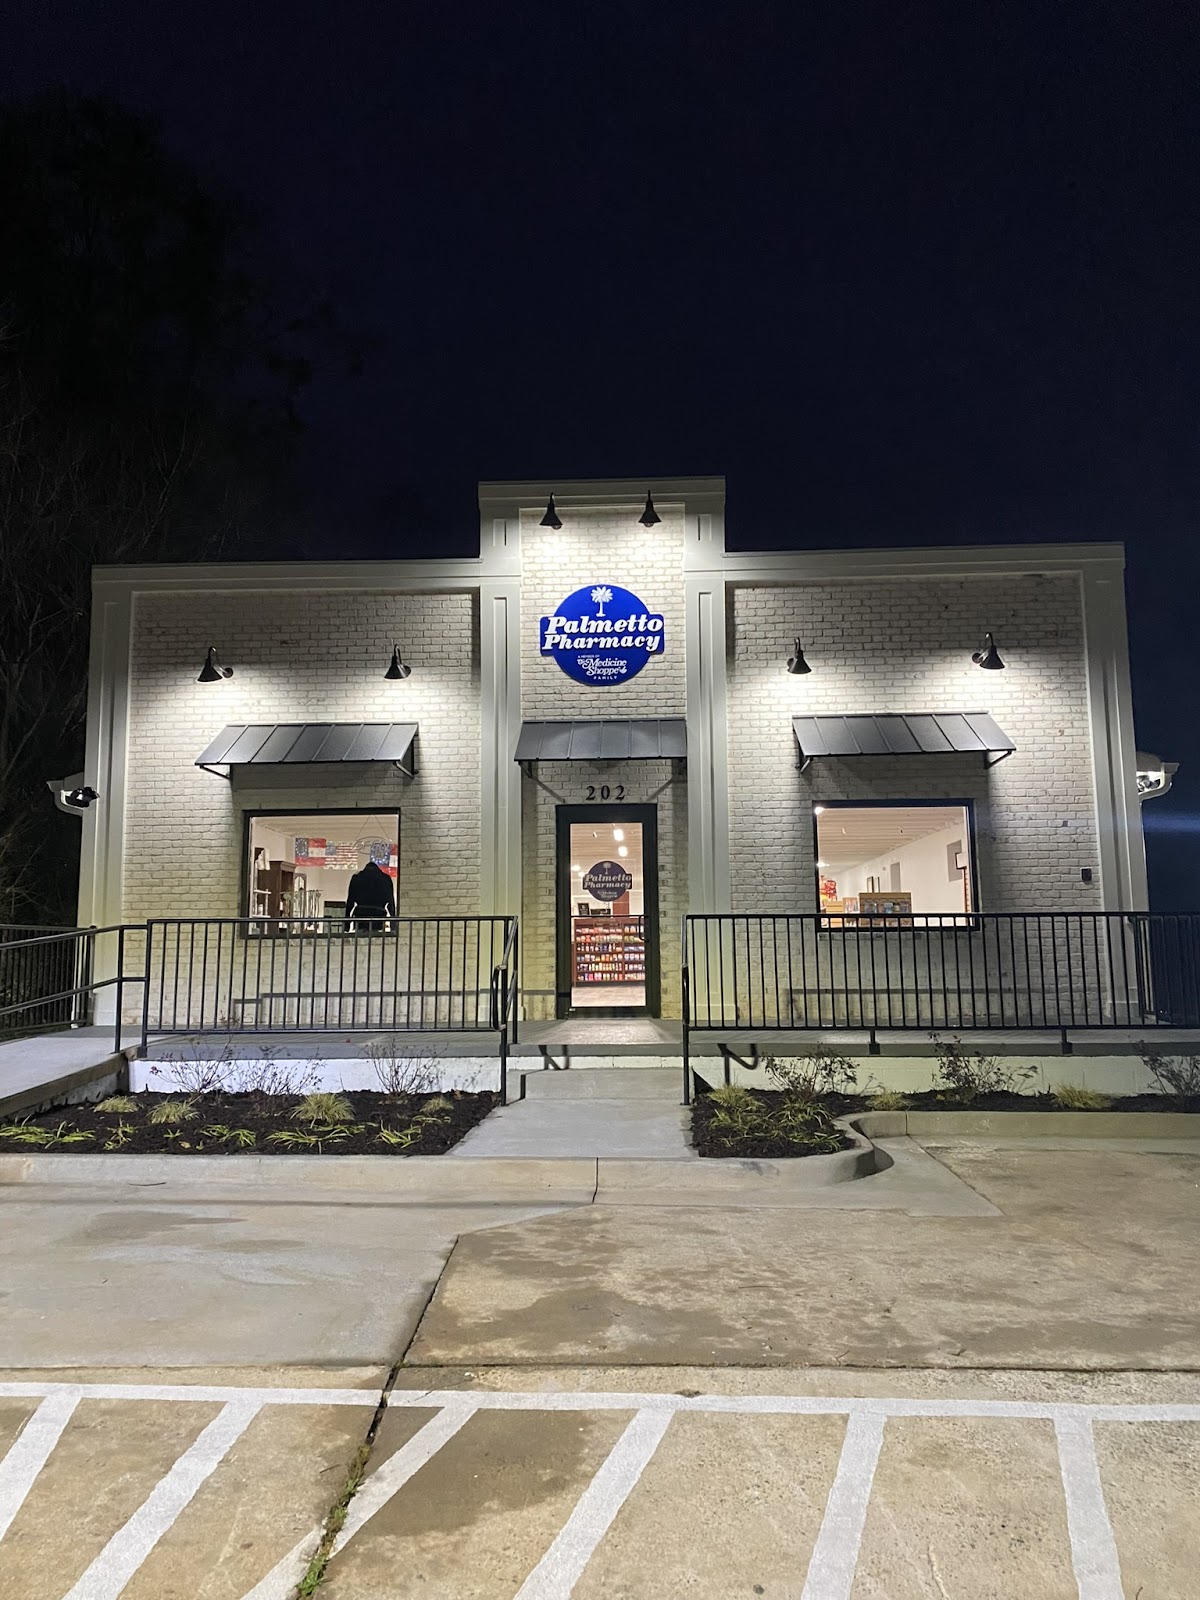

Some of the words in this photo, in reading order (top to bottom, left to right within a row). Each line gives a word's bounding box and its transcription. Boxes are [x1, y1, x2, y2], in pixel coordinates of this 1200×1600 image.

[544, 614, 663, 634] Palmetto
[541, 634, 661, 651] Pharmacy
[582, 658, 627, 669] Medicine
[586, 667, 619, 676] Shoppe
[586, 785, 625, 800] 202
[585, 873, 632, 882] Palmetto
[584, 881, 631, 889] Pharmacy
